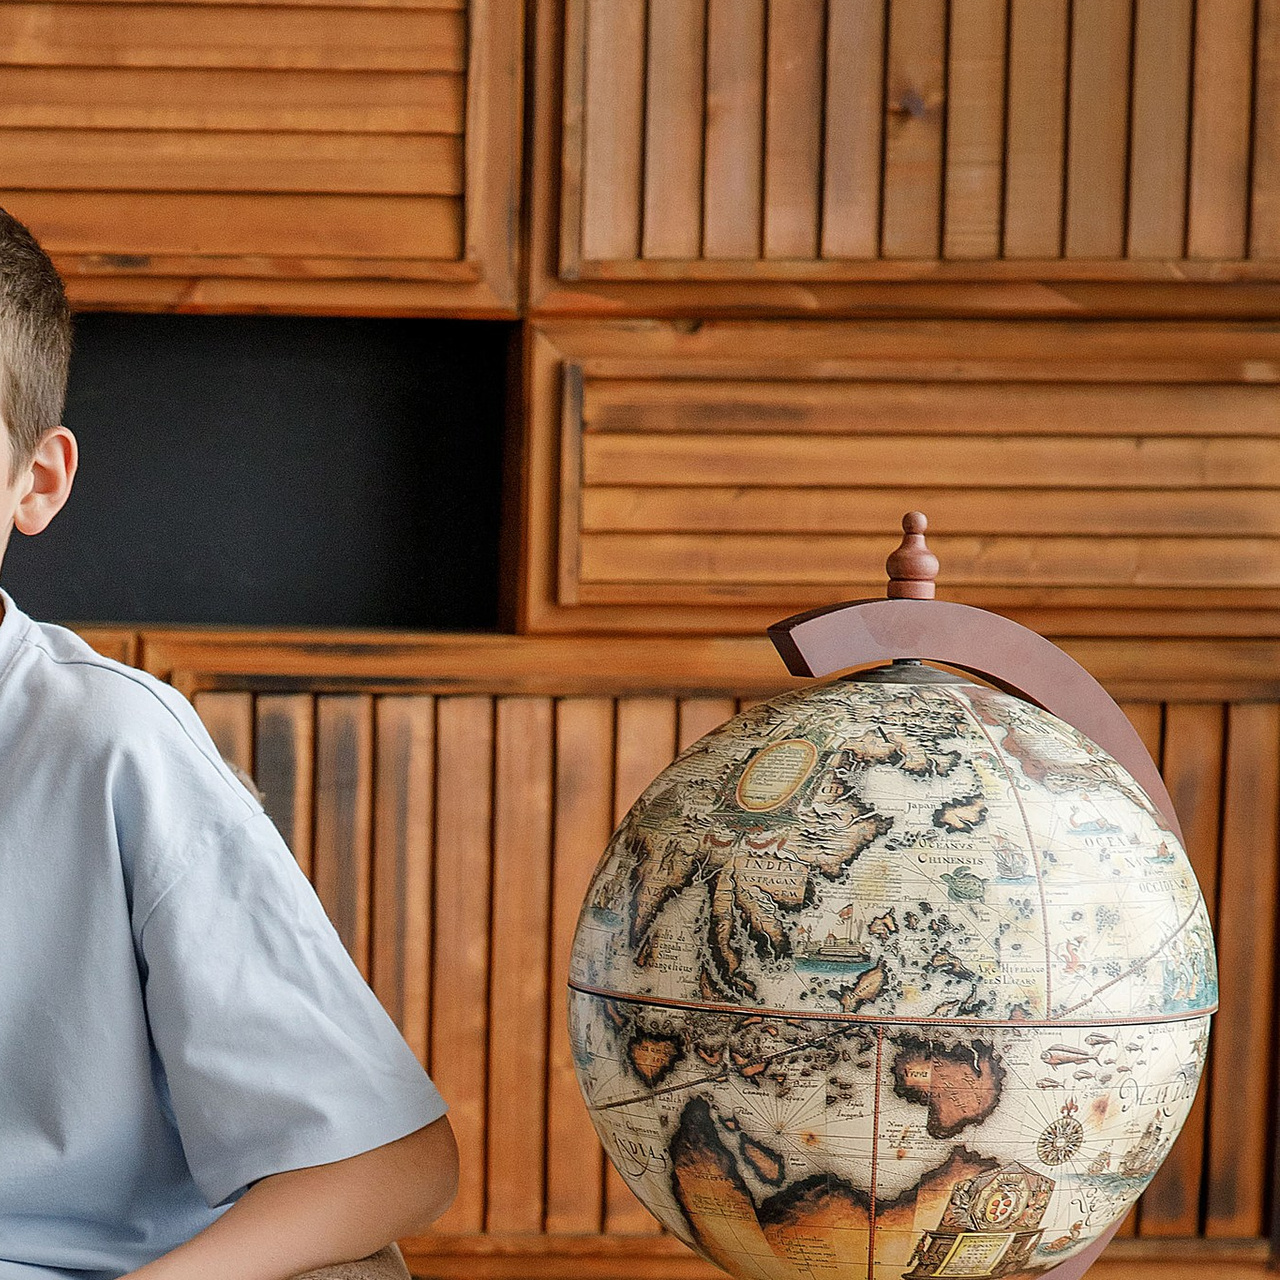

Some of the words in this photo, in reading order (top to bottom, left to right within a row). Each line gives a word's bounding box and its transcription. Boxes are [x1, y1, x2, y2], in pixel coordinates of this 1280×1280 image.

[904, 802, 936, 814] Japan
[917, 853, 984, 865] CHINENSIS
[745, 859, 794, 872] INDIA
